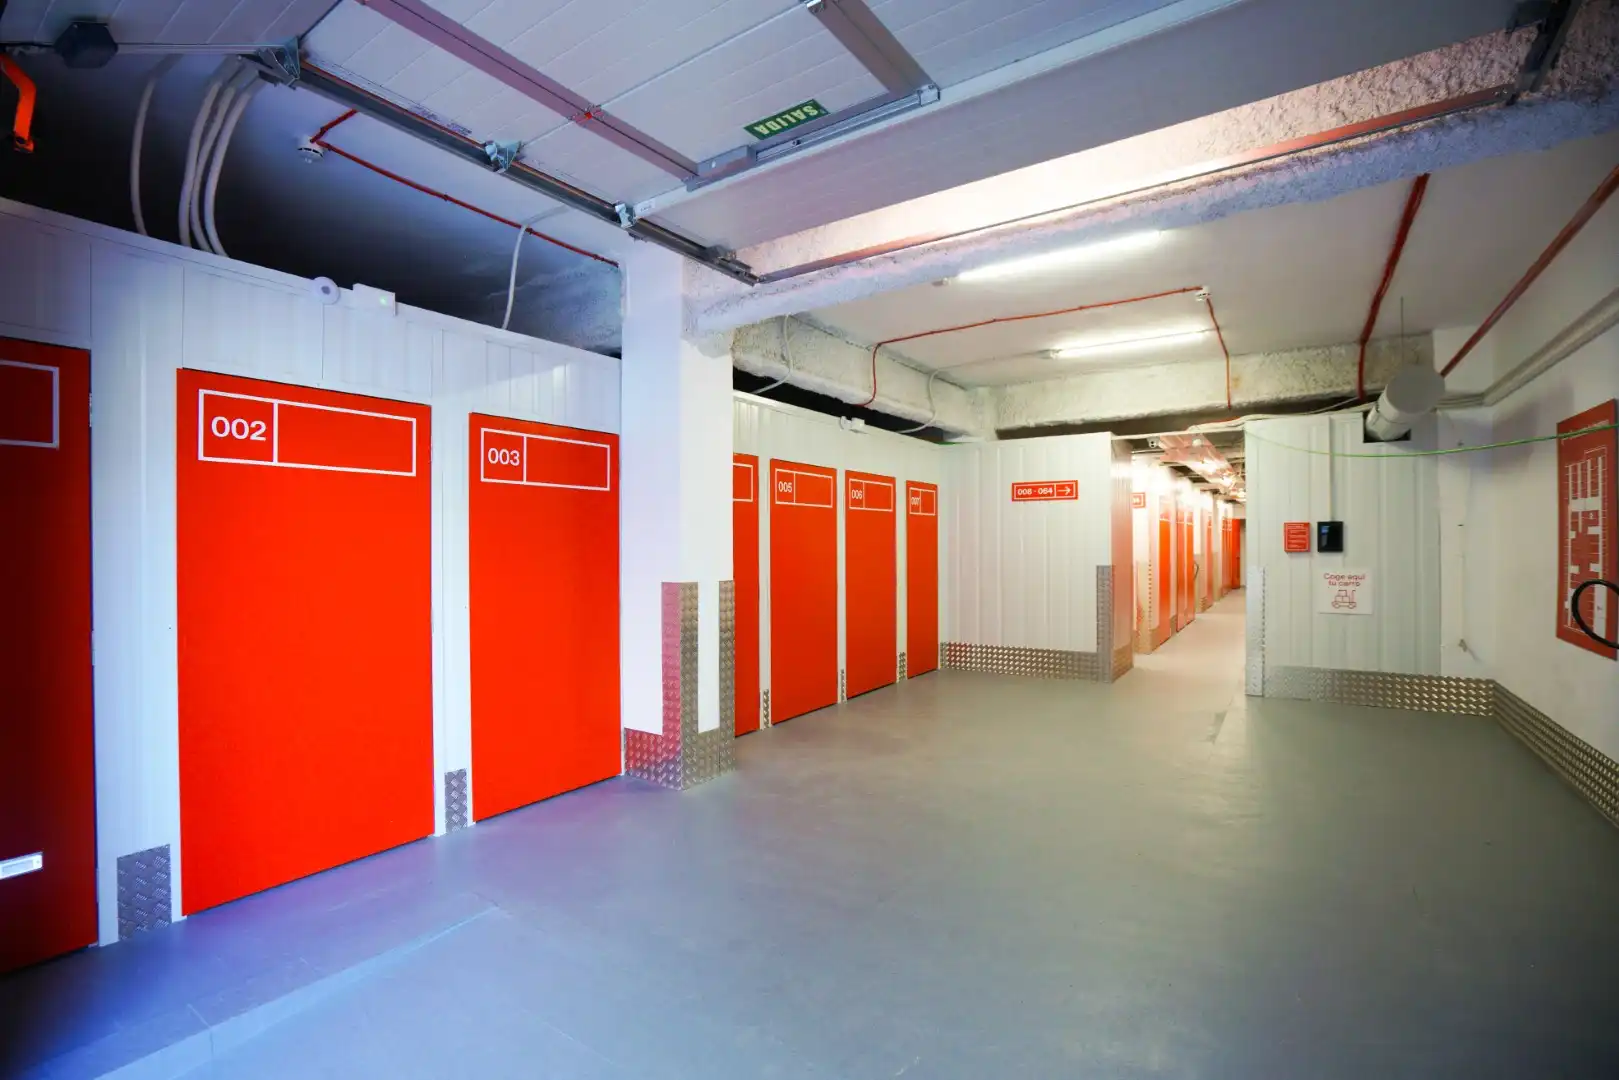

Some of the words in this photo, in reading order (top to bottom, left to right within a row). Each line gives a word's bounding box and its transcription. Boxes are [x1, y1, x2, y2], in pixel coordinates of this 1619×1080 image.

[754, 105, 818, 135] SALIDA
[211, 416, 267, 441] 002
[488, 447, 520, 466] 003
[778, 481, 793, 493] 005
[1017, 488, 1032, 496] 008
[1038, 487, 1053, 495] 064
[851, 489, 863, 500] 006
[1323, 572, 1345, 582] Coge
